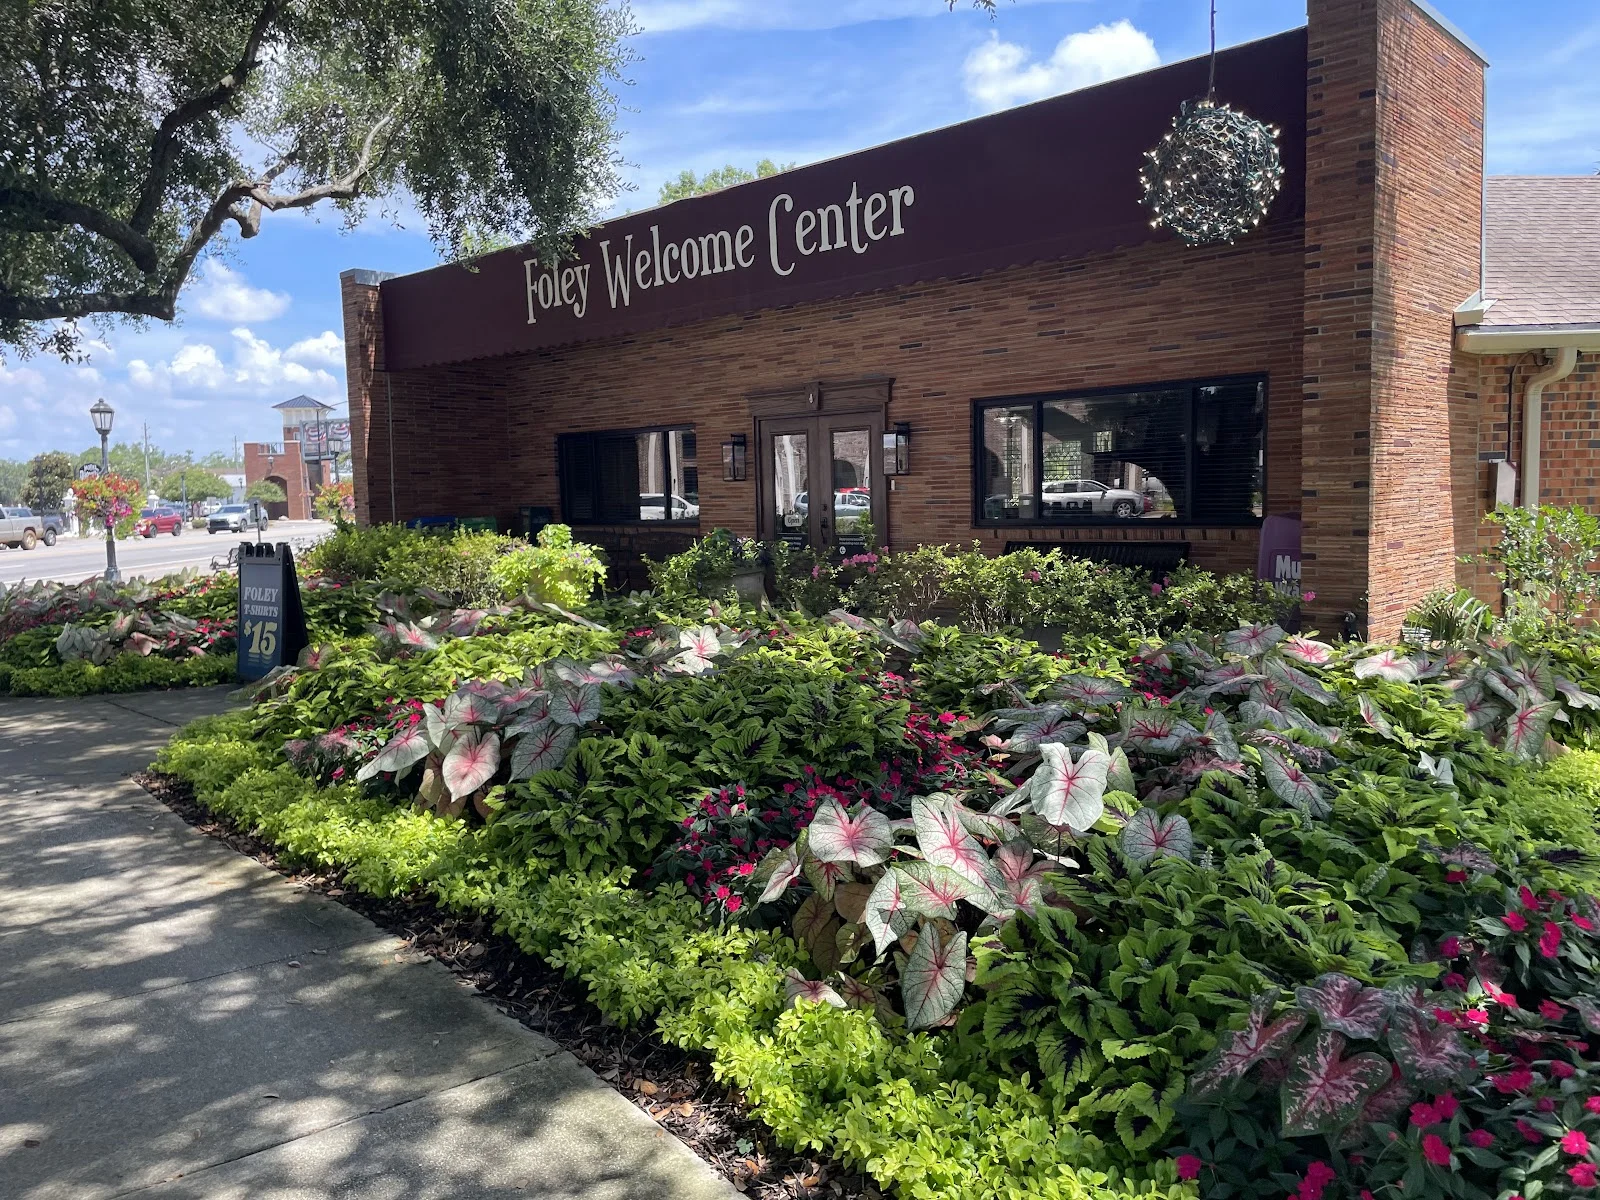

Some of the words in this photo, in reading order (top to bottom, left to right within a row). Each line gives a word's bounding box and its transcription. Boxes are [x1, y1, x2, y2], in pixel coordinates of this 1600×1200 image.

[523, 254, 591, 325] Foley
[600, 224, 755, 309] Welcome
[768, 180, 915, 276] Center
[243, 586, 279, 603] FOLEY
[243, 604, 279, 618] T-SHIRTS
[243, 619, 278, 655] $15
